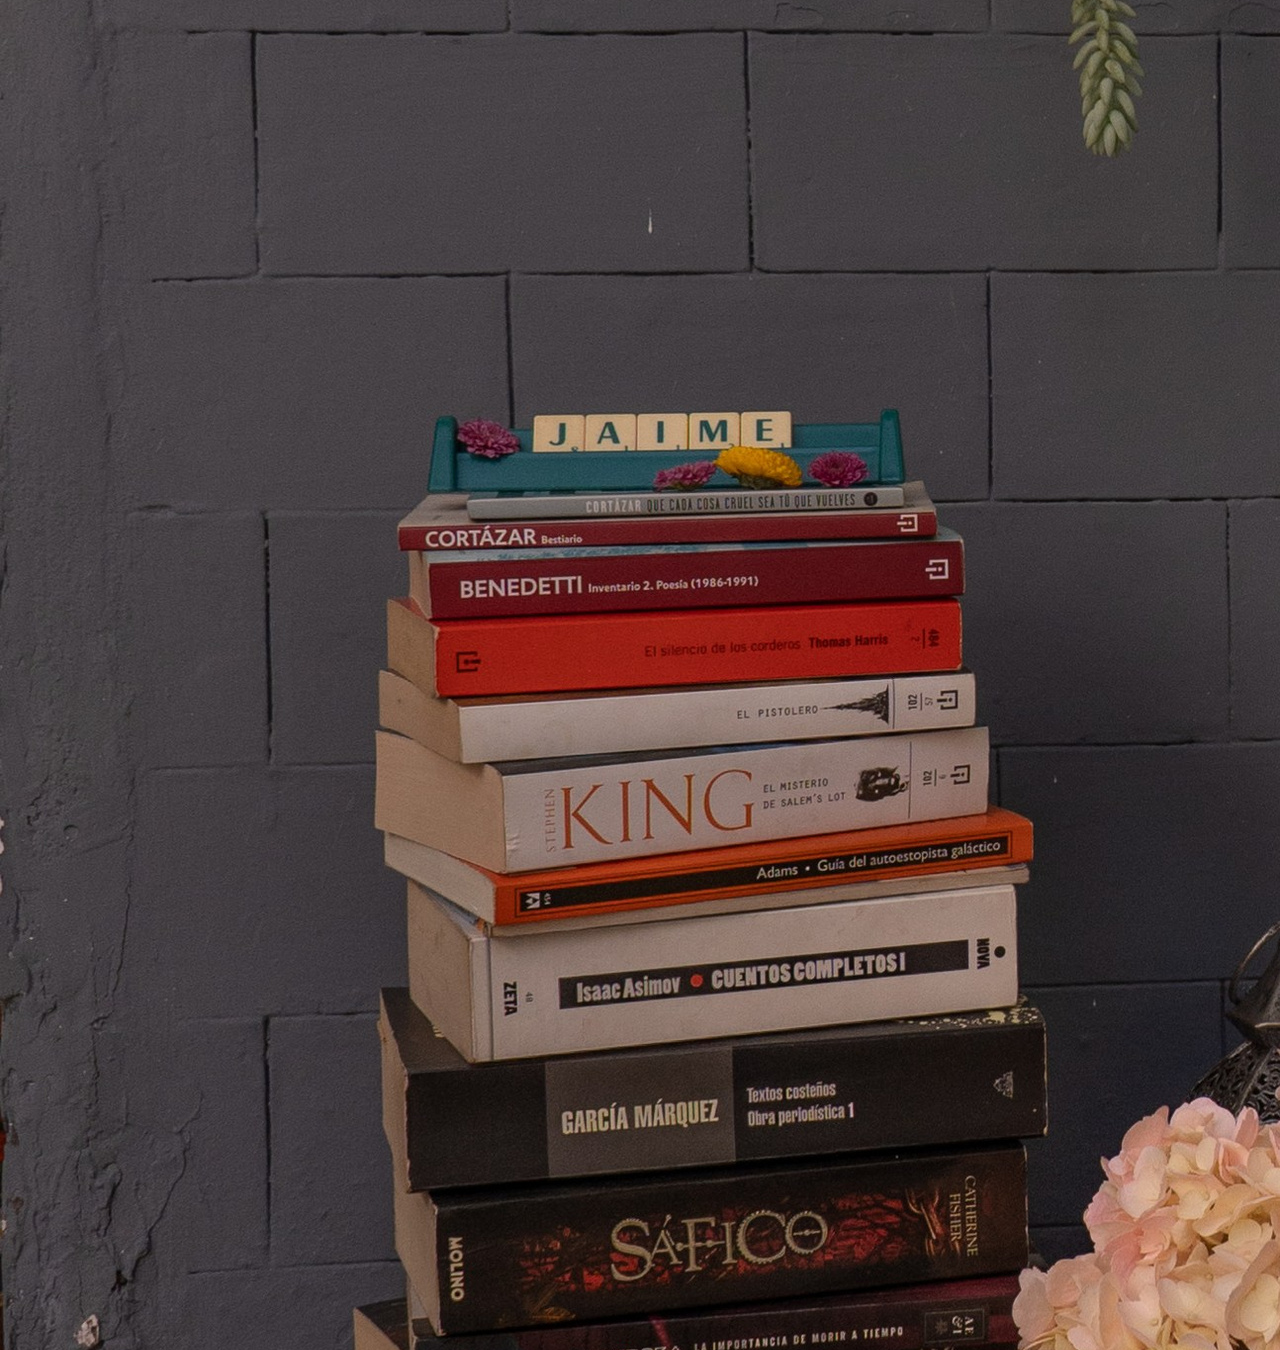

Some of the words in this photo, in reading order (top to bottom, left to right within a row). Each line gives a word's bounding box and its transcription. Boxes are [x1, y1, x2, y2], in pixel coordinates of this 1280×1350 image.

[549, 418, 773, 447] JAIME
[585, 498, 642, 515] CORTÁZAR
[646, 499, 668, 513] QUE
[669, 499, 694, 512] CADA
[697, 498, 721, 511] COSA
[724, 497, 751, 510] CRUEL
[758, 496, 776, 509] SEA
[794, 495, 813, 508] QUE
[816, 493, 856, 507] VUELVES
[425, 525, 537, 548] CORTÁZAR
[541, 533, 583, 545] Bestiario
[460, 575, 583, 600] BENEDETTI
[588, 582, 640, 594] Inventario
[656, 578, 688, 590] Poesía
[691, 575, 759, 590] (1986-1991)
[645, 645, 657, 657] El
[661, 643, 707, 656] silencio
[751, 639, 800, 652] corderos
[808, 635, 851, 649] Thomas
[855, 633, 889, 647] Harris
[758, 705, 819, 719] PISTOLERO
[780, 777, 829, 792] MISTERIO
[560, 768, 755, 850] KING
[780, 793, 823, 809] SALEM'S
[544, 787, 556, 853] STEPHEN
[756, 865, 799, 880] Adams
[817, 858, 845, 872] Guía
[870, 846, 948, 867] autoestopista
[951, 840, 1001, 859] galáctico
[976, 937, 991, 970] NOVA
[577, 980, 621, 1004] Isaac
[623, 975, 682, 999] Asimov
[711, 962, 794, 990] CUENTOS
[794, 953, 898, 982] COMPLETOS
[503, 981, 518, 1016] ZETA
[747, 1085, 783, 1104] Textos
[786, 1080, 837, 1100] costeños
[561, 1102, 629, 1135] GARCÍA
[634, 1098, 719, 1129] MÁRQUEZ
[747, 1109, 776, 1127] Obra
[778, 1103, 845, 1127] periodística
[949, 1192, 962, 1242] FISHER
[965, 1174, 979, 1257] CATHERINE
[448, 1236, 465, 1301] MOLINO
[812, 1331, 846, 1343] MORIR
[863, 1326, 904, 1340] TIEMPO
